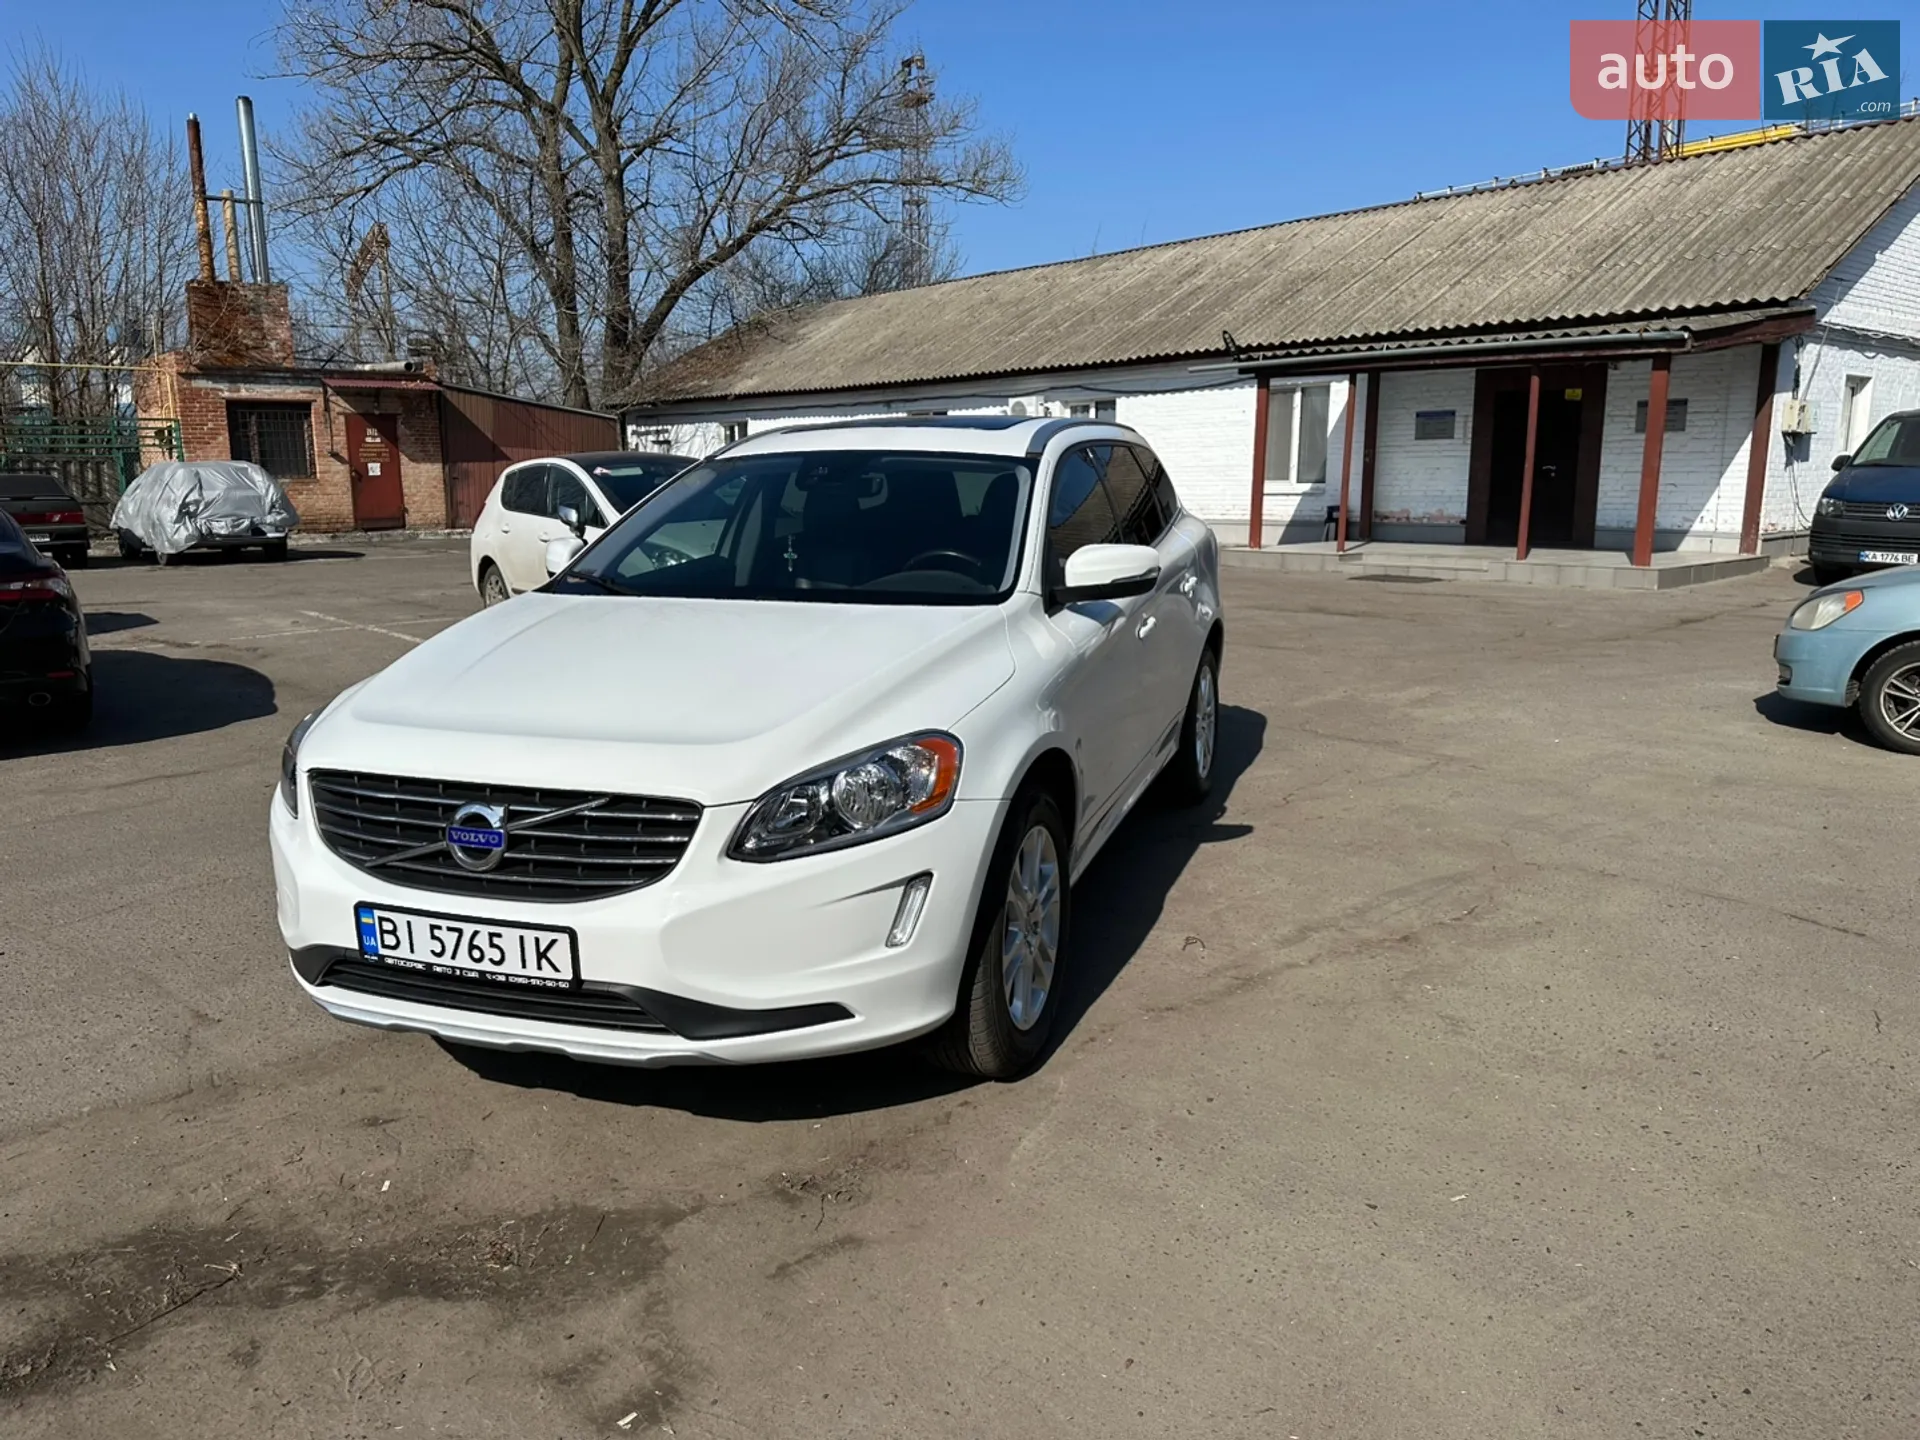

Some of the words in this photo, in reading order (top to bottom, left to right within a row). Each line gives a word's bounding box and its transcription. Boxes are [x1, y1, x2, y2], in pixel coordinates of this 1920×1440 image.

[1881, 553, 1899, 562] 1776
[450, 830, 499, 844] VOLVO
[362, 935, 377, 947] UA
[377, 915, 415, 954] BI
[429, 922, 506, 967] 5765
[518, 933, 562, 973] IK
